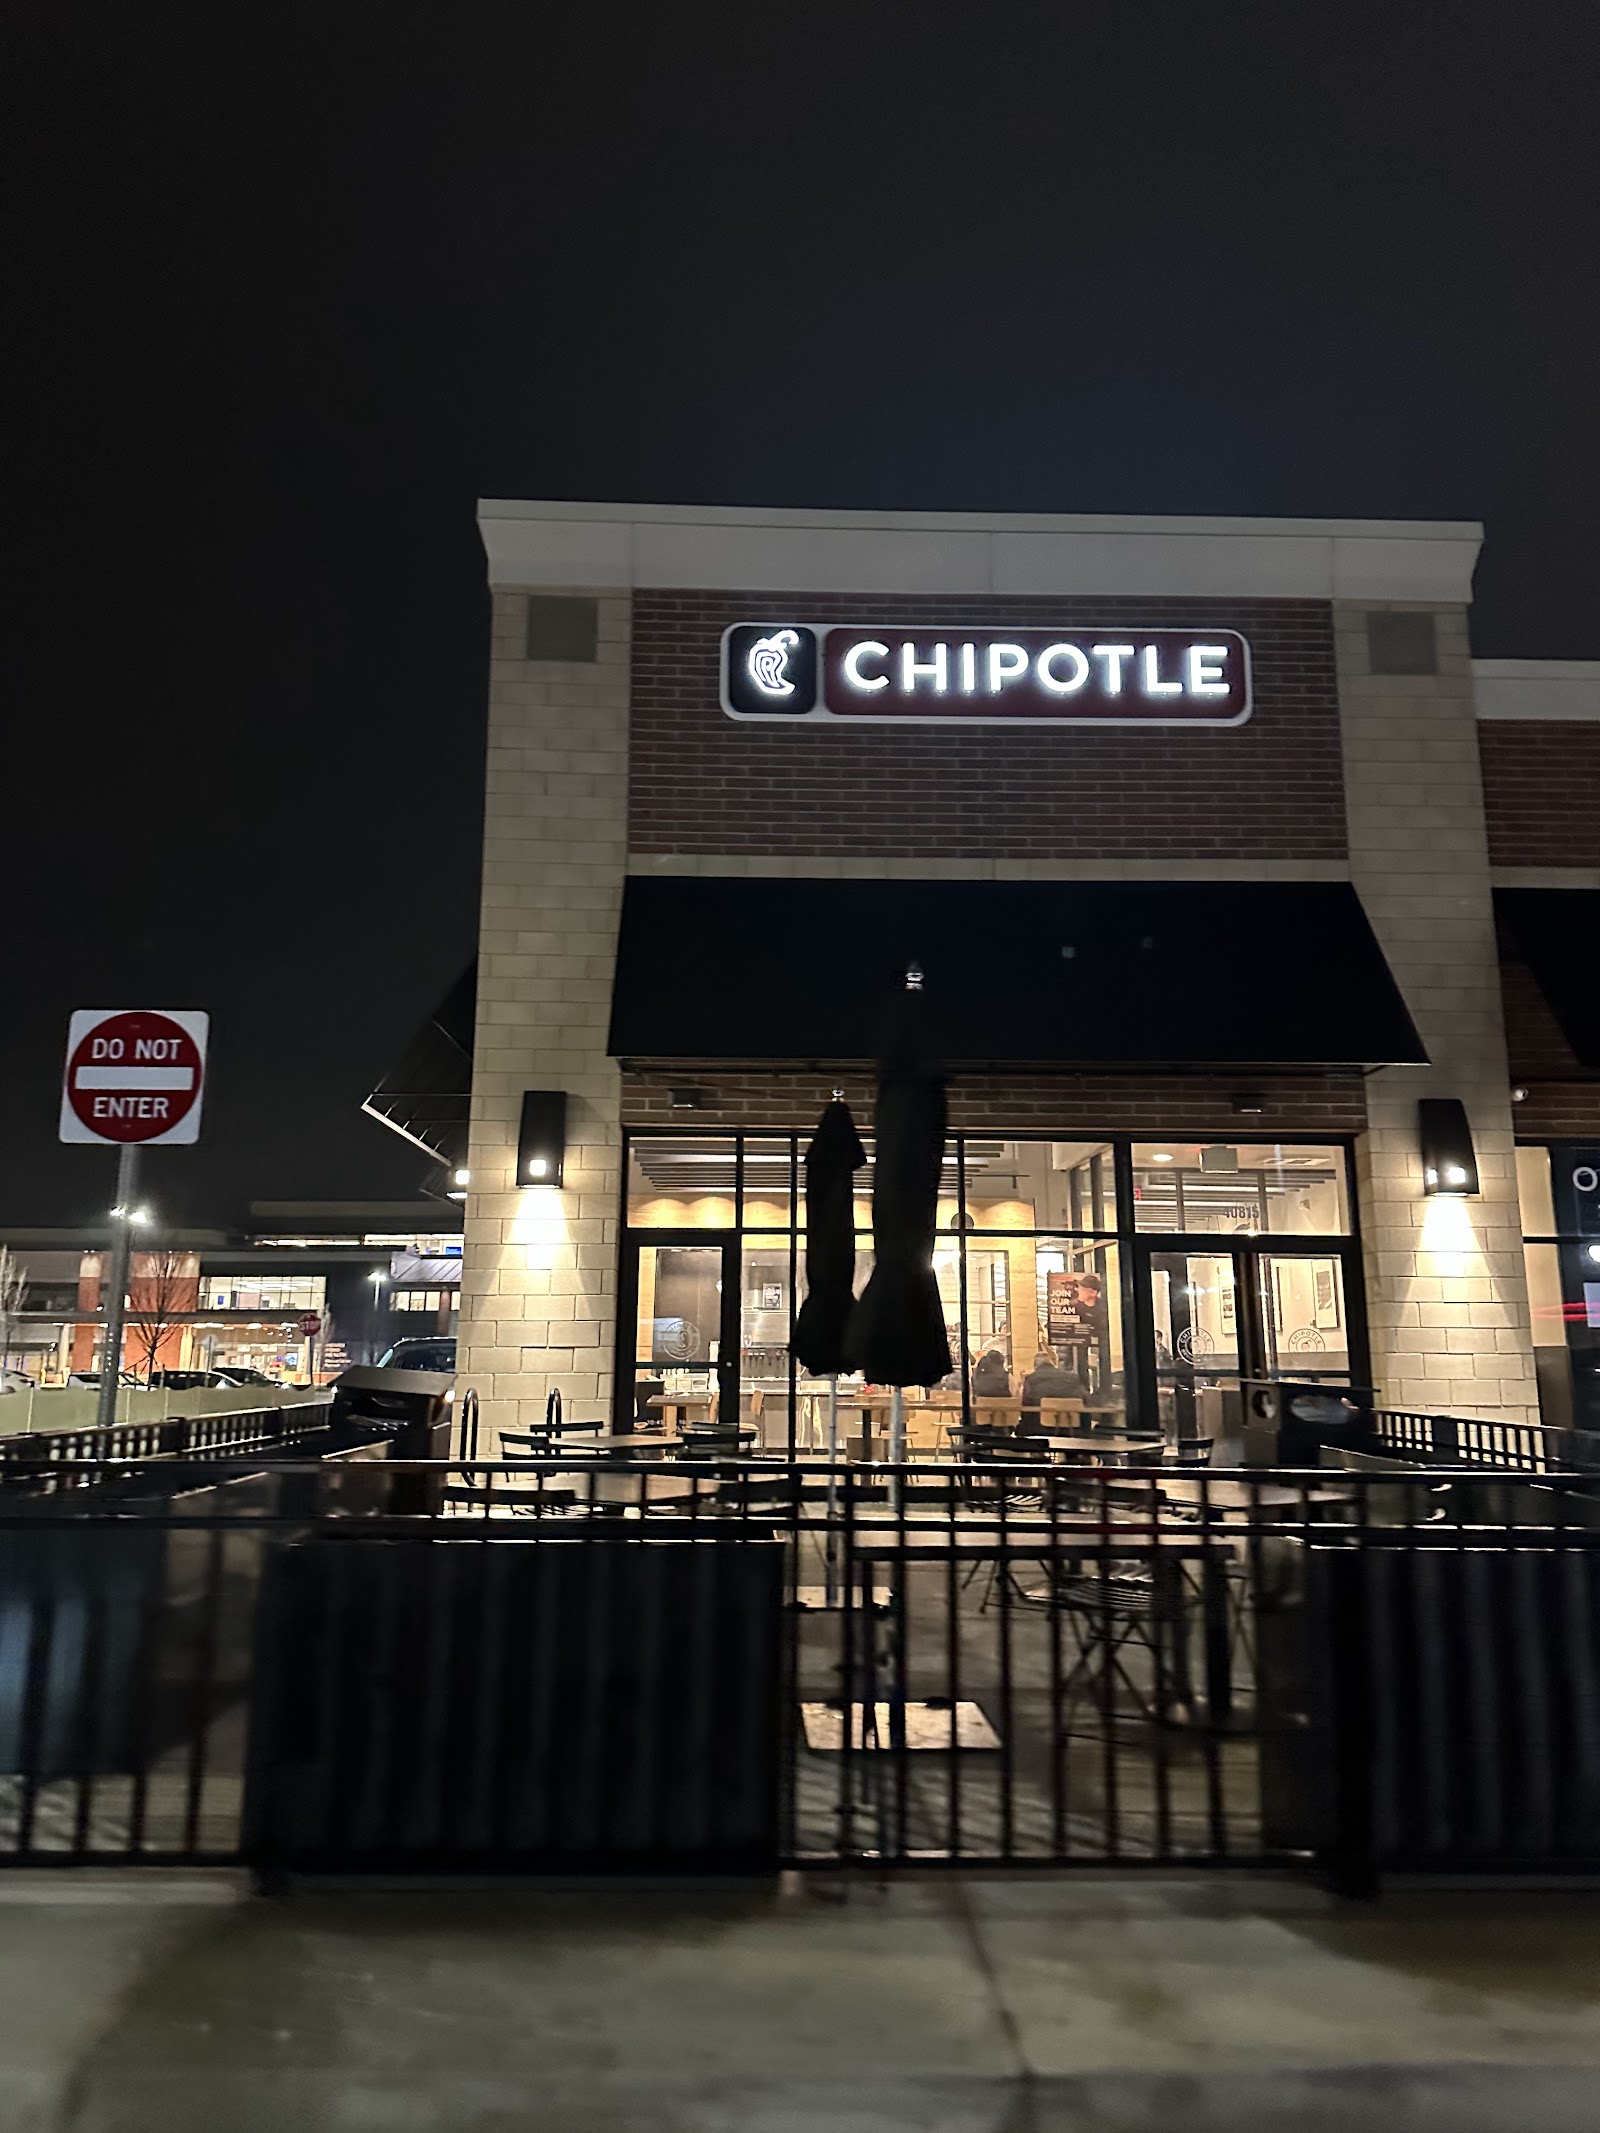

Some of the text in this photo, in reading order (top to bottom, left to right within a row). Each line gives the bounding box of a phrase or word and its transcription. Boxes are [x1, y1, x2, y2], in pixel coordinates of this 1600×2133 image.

[843, 640, 1231, 693] CHIPOTLE
[92, 1038, 183, 1060] DO NOT
[93, 1097, 170, 1119] ENTER
[1050, 1289, 1072, 1298] JOIN
[1050, 1298, 1071, 1306] OUR
[1050, 1306, 1076, 1315] TEAM
[1291, 1330, 1323, 1345] CHIPOTLE
